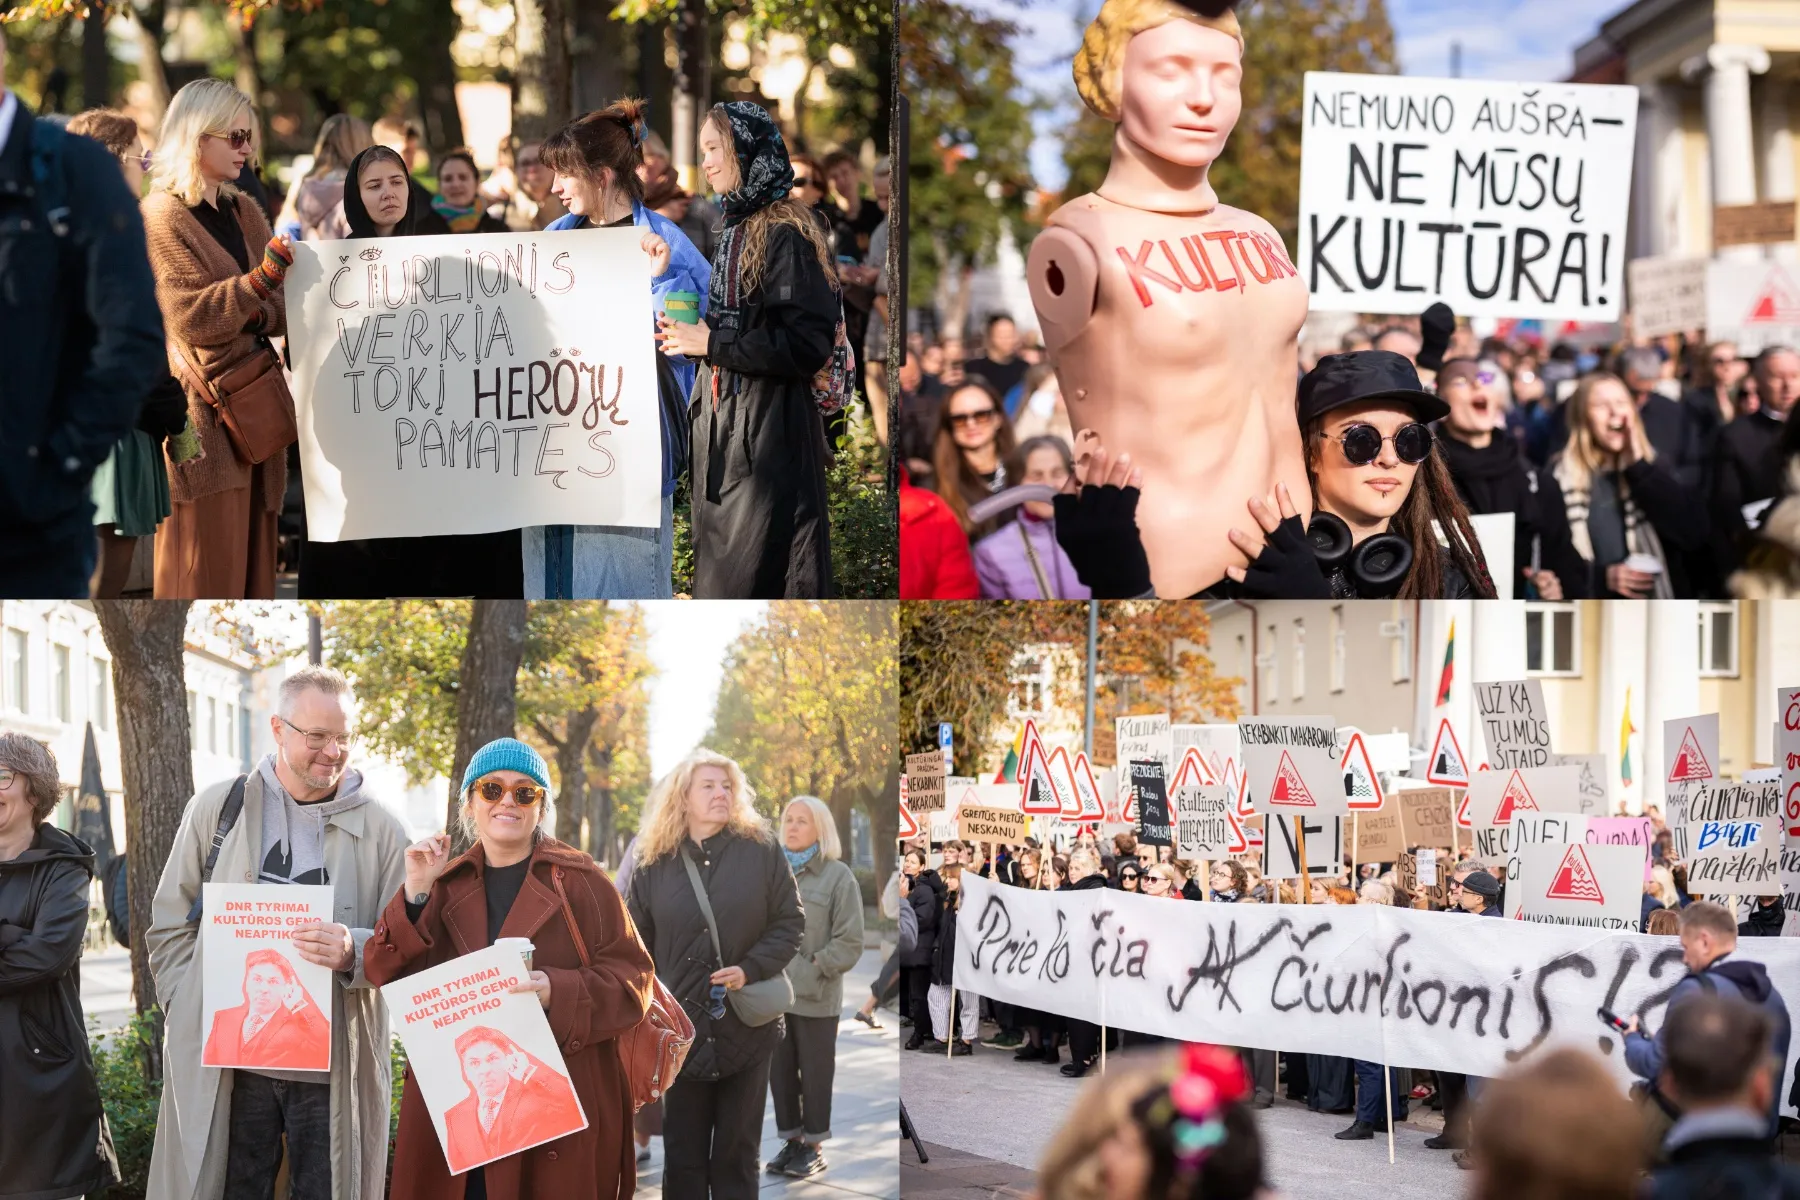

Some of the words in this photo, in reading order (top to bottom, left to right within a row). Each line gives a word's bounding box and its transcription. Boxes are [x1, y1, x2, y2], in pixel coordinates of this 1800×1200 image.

[1311, 91, 1454, 134] NEMUNO
[1347, 142, 1429, 205] NE
[1450, 148, 1584, 223] MŪSŲ
[1310, 213, 1610, 306] KULTŪRA!
[336, 304, 514, 368] VERKIA
[343, 363, 445, 416] TOKĮ
[395, 418, 616, 490] PAMATĘS
[1508, 683, 1535, 721] KĄ
[942, 728, 951, 742] P
[1238, 723, 1289, 745] NEKABINKIT
[1290, 726, 1338, 760] MAKARONŲ!
[1486, 720, 1511, 742] TU
[907, 775, 945, 792] NEKABINKIT
[962, 809, 996, 823] GREITŪS
[1000, 812, 1025, 825] PIETŪS
[967, 823, 1016, 839] NESKANU
[1566, 854, 1586, 880] kultūra
[213, 915, 282, 926] KULTŪROS
[225, 901, 253, 912] DNR
[255, 902, 310, 913] TYRIMAI
[1090, 910, 1150, 979] čia
[404, 989, 478, 1025] KULTŪROS
[481, 976, 519, 997] GENO
[411, 987, 442, 1006] DNR
[444, 966, 501, 994] TYRIMAI
[432, 997, 502, 1030] NEAPTIKO
